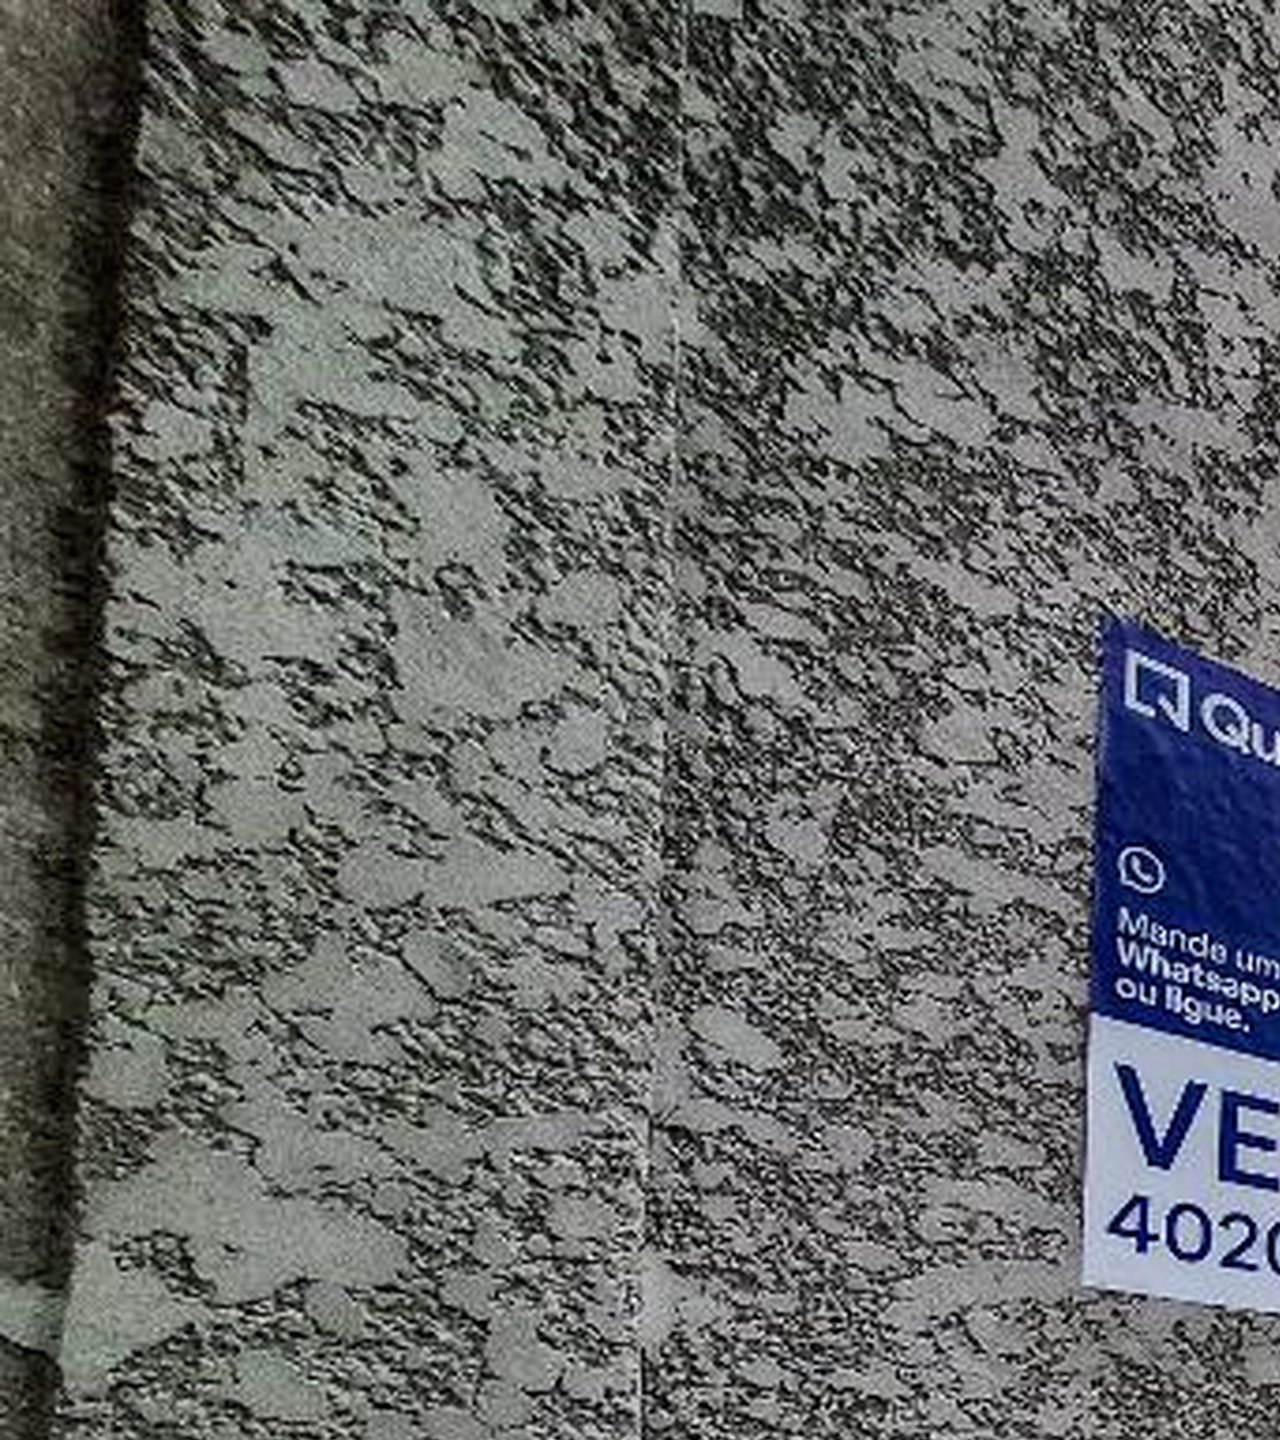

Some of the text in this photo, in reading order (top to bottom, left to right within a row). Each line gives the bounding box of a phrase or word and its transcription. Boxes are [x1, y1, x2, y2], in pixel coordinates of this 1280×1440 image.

[1117, 906, 1228, 965] Mande
[1115, 977, 1251, 1033] ou ligue.
